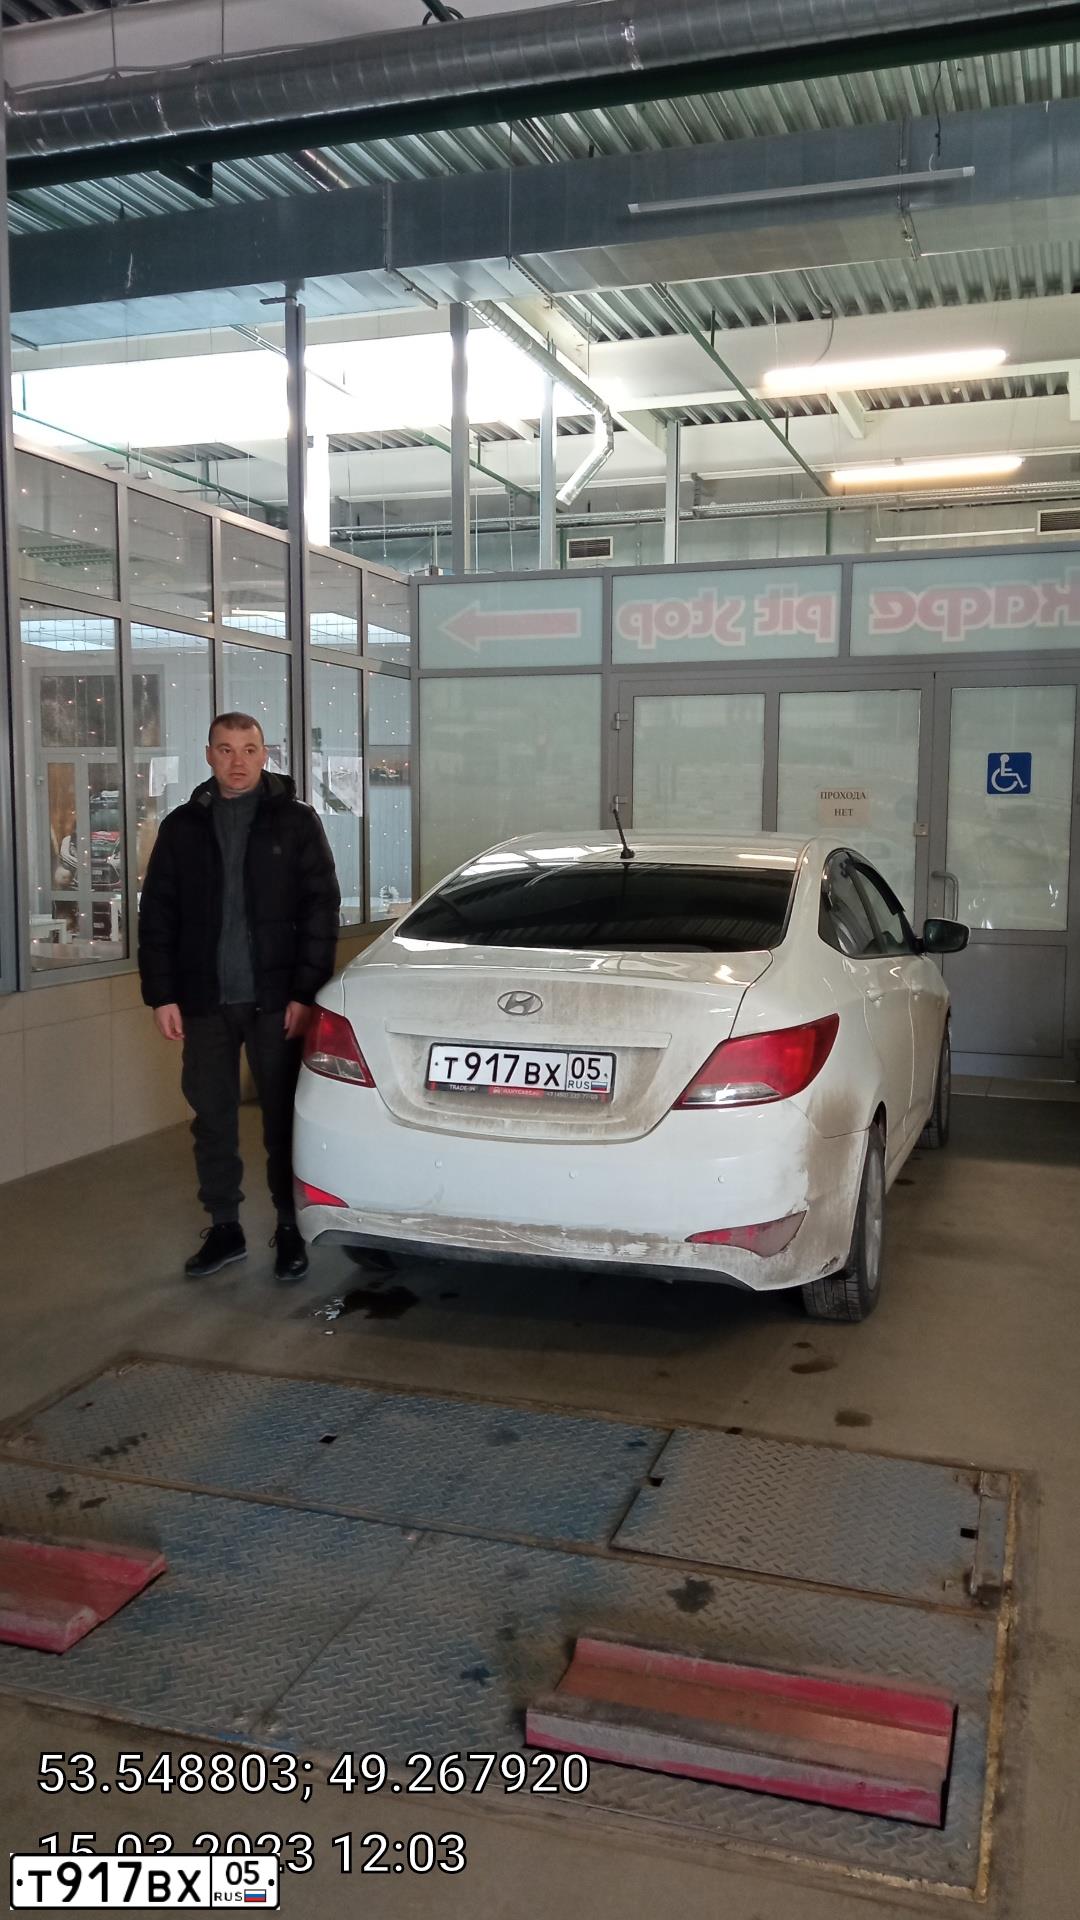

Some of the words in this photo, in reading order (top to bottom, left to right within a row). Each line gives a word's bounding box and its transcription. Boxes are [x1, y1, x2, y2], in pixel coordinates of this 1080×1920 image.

[820, 791, 867, 800] ПРОХОДА
[834, 808, 854, 817] НЕТ
[571, 1057, 601, 1080] 05
[567, 1080, 590, 1090] RUS
